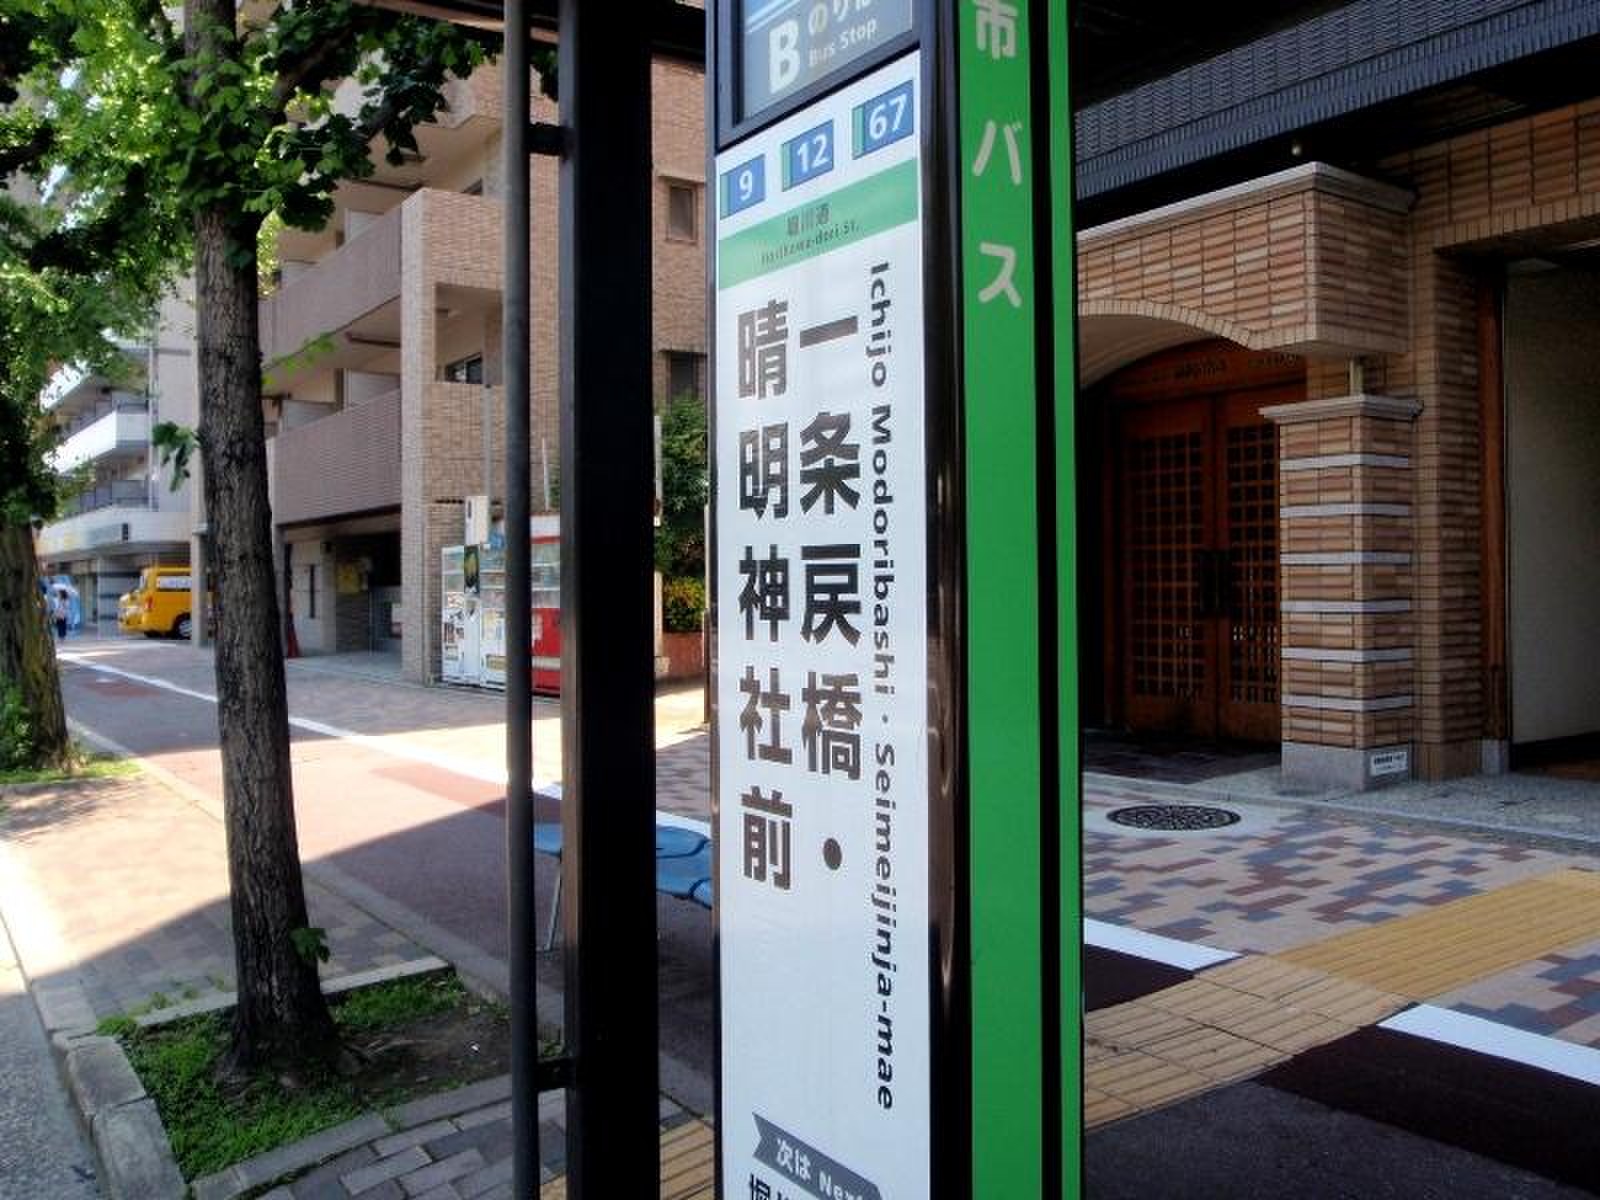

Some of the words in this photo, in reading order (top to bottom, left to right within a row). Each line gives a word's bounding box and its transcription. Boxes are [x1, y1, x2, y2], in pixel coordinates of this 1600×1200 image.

[769, 20, 799, 94] B
[839, 18, 877, 49] Stop
[797, 134, 828, 173] 12
[869, 94, 907, 140] 67
[972, 0, 1022, 308] 市バス
[739, 169, 753, 201] 9
[866, 262, 892, 388] Ichijo
[872, 404, 895, 695] Modoribashi
[737, 299, 793, 890] 晴明神社前
[871, 742, 896, 1110] Seimeijinja-mae
[776, 1138, 812, 1181] 次は
